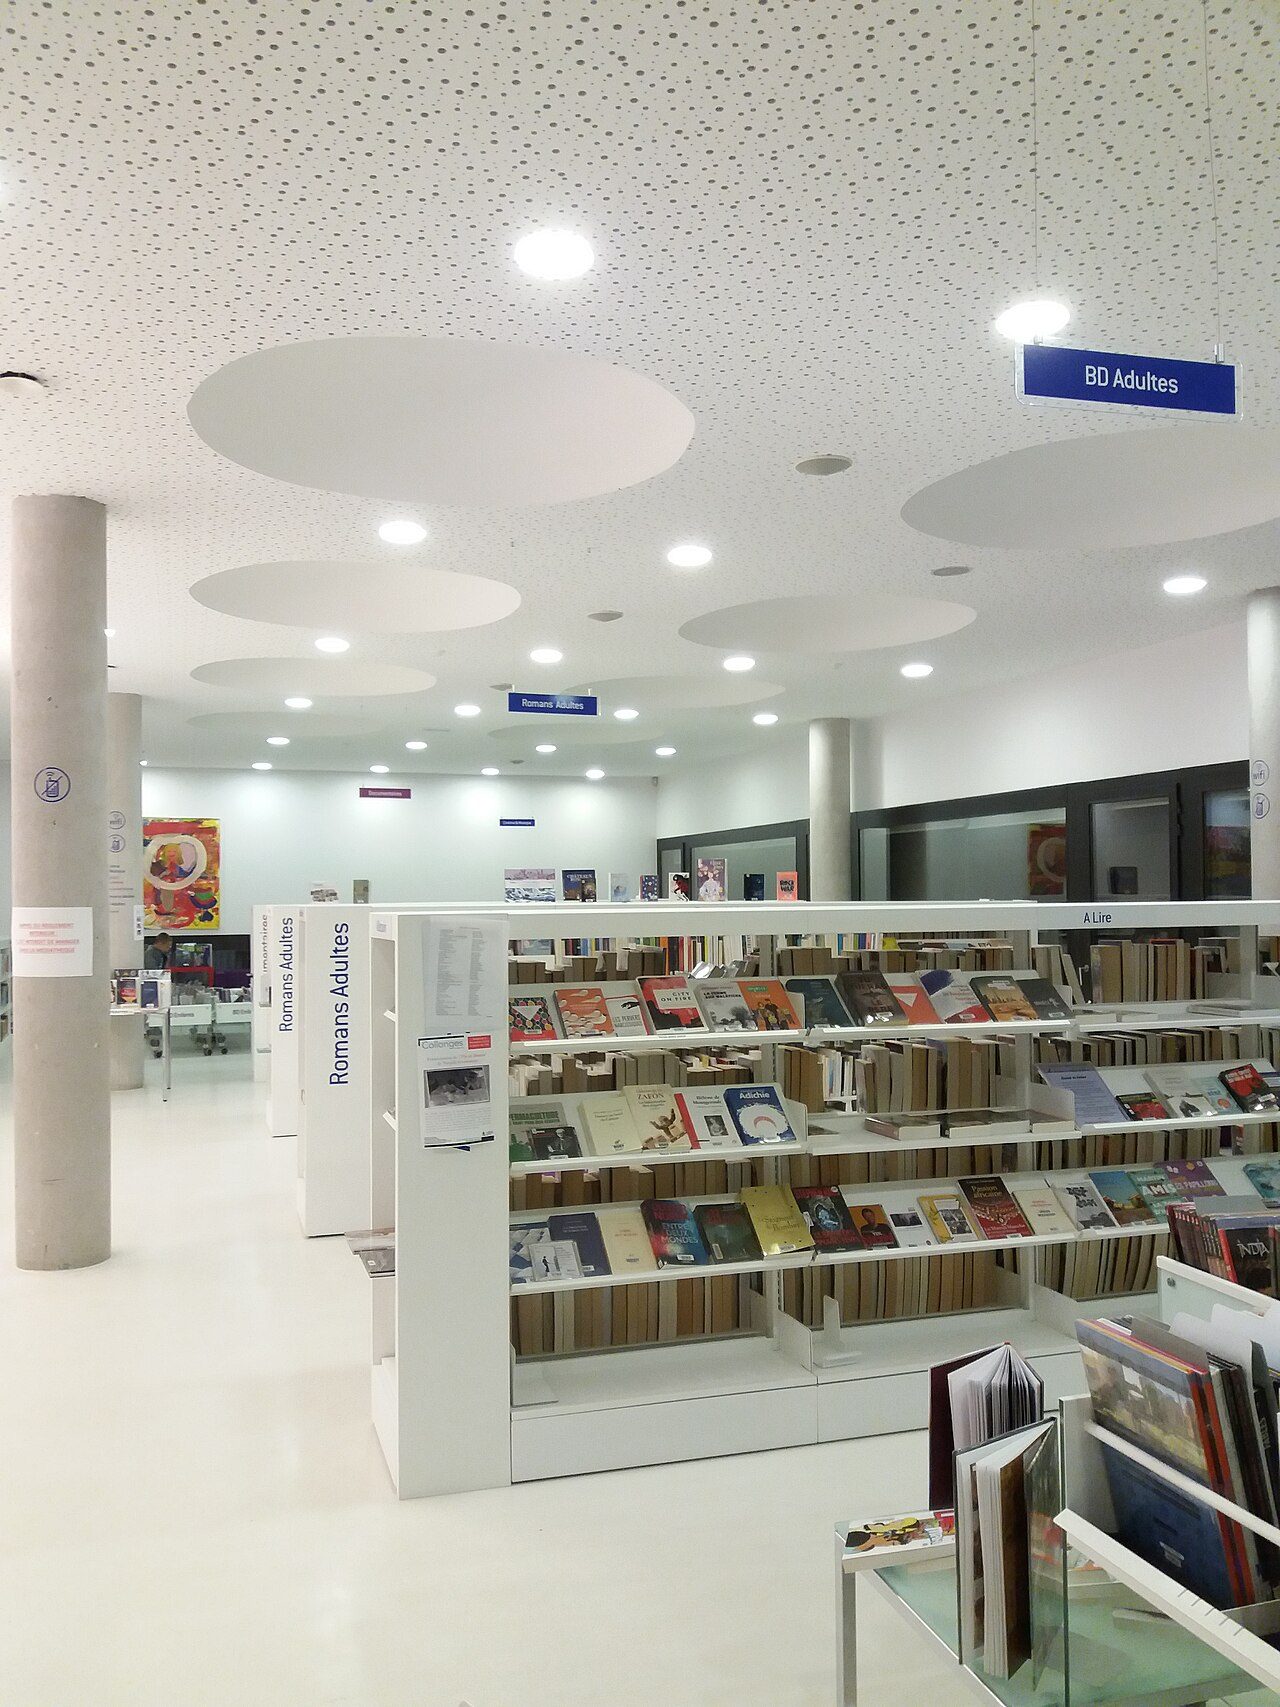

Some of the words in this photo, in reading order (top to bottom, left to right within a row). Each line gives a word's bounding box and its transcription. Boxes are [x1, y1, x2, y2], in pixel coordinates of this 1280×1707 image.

[1085, 365, 1108, 387] BD
[1113, 368, 1179, 394] Adultes
[521, 698, 553, 709] Romans
[555, 700, 584, 710] Adultes
[1083, 912, 1091, 924] A
[1092, 911, 1112, 924] Lire
[278, 917, 293, 970] Adultes
[329, 922, 349, 997] Adultes
[278, 973, 293, 1032] Romans
[329, 1003, 349, 1085] Romans
[739, 1091, 771, 1100] Adichie
[971, 1185, 999, 1193] Passion
[1142, 1184, 1177, 1196] AMIS
[662, 1222, 690, 1231] ENTRE
[661, 1235, 699, 1244] MONDES
